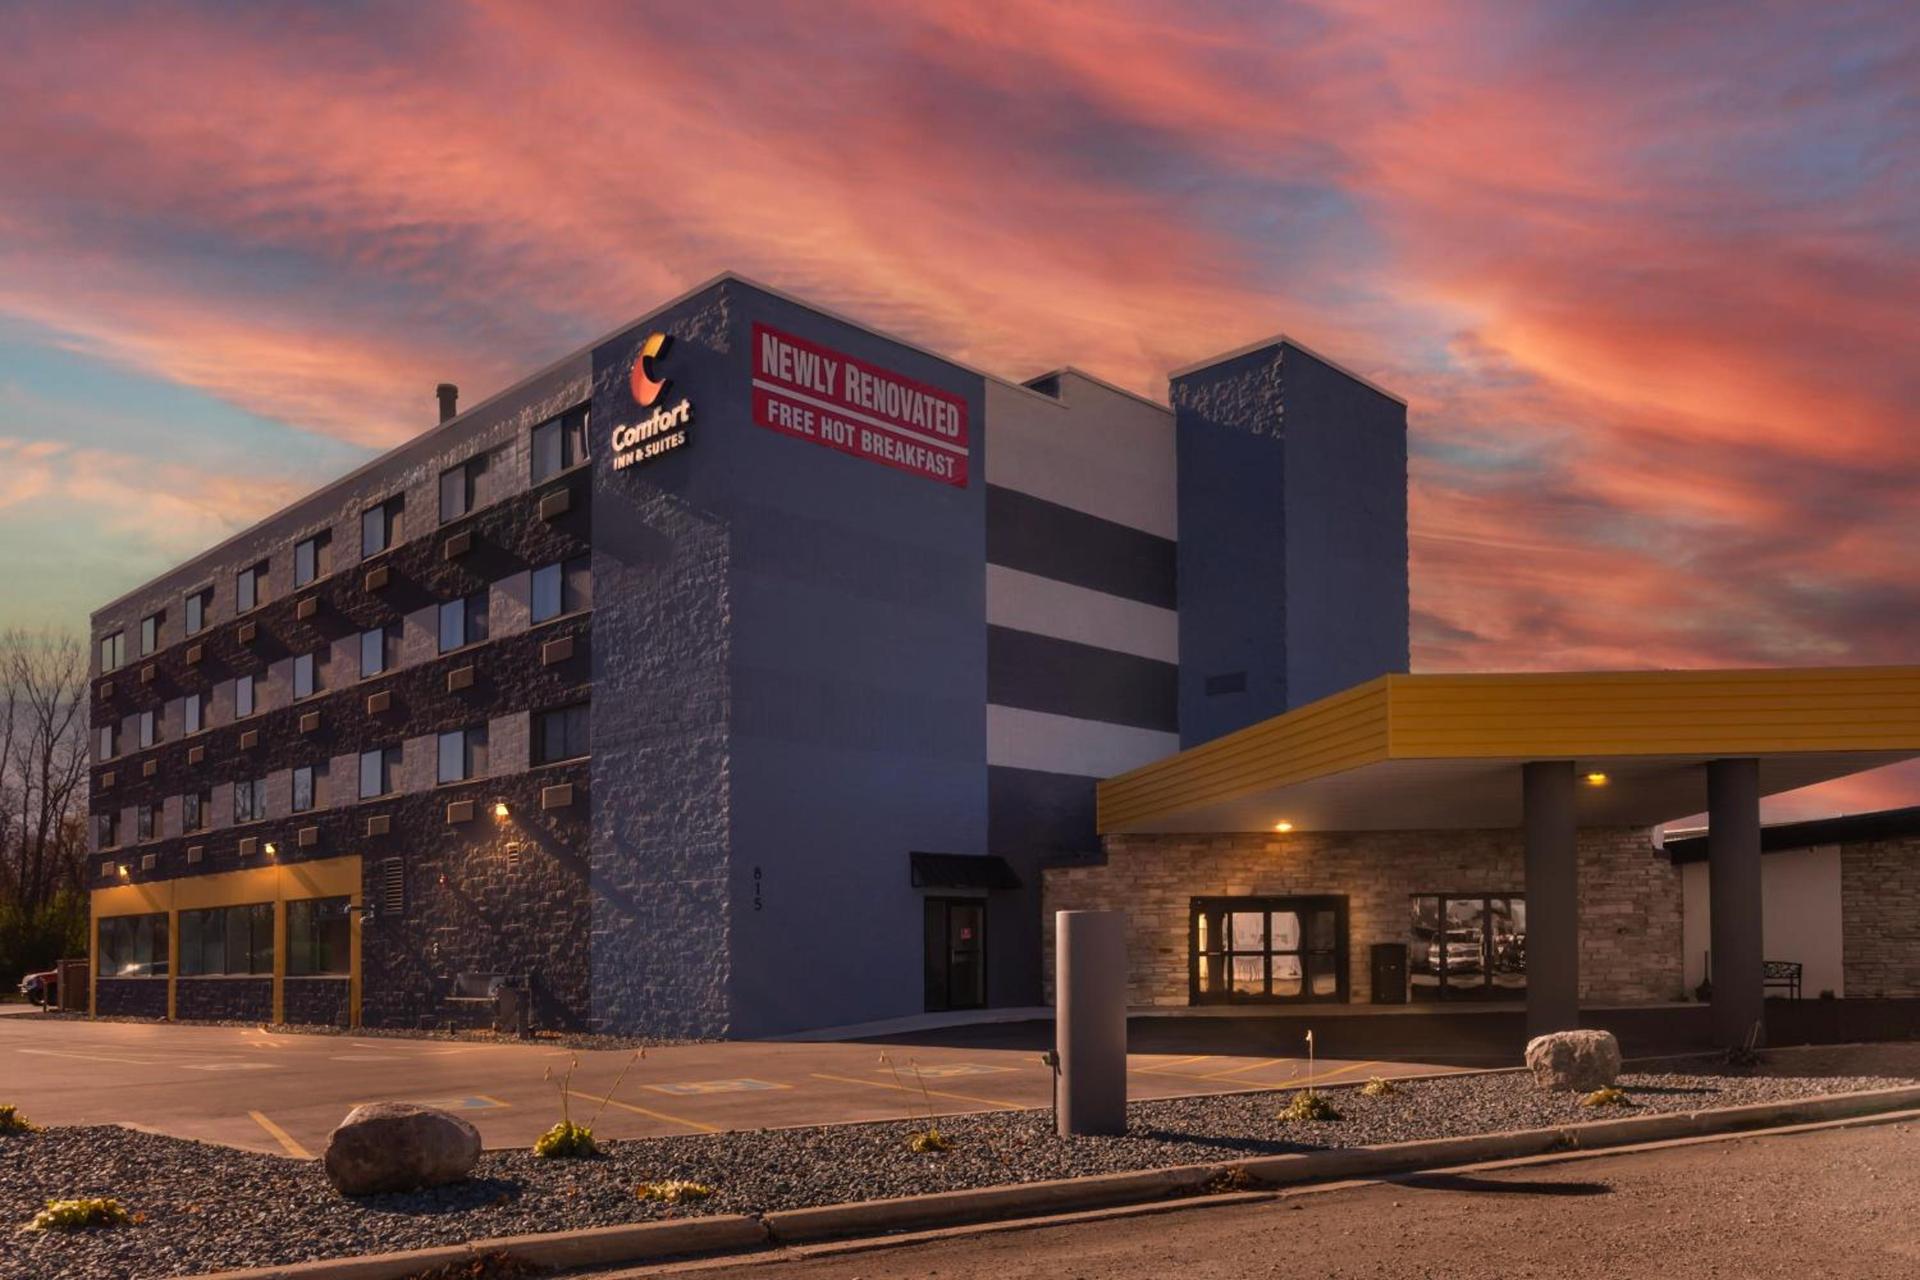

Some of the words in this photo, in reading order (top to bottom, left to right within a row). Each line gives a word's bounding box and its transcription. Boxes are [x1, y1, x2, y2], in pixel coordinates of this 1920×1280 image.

[762, 333, 838, 395] NEWLY
[845, 363, 959, 437] RENOVATED
[611, 399, 690, 452] Comfort
[613, 451, 634, 471] INN
[635, 448, 644, 462] &
[644, 431, 686, 458] SUITES
[768, 399, 815, 435] FREE
[821, 416, 856, 447] HOT
[861, 430, 955, 478] BREAKFAST
